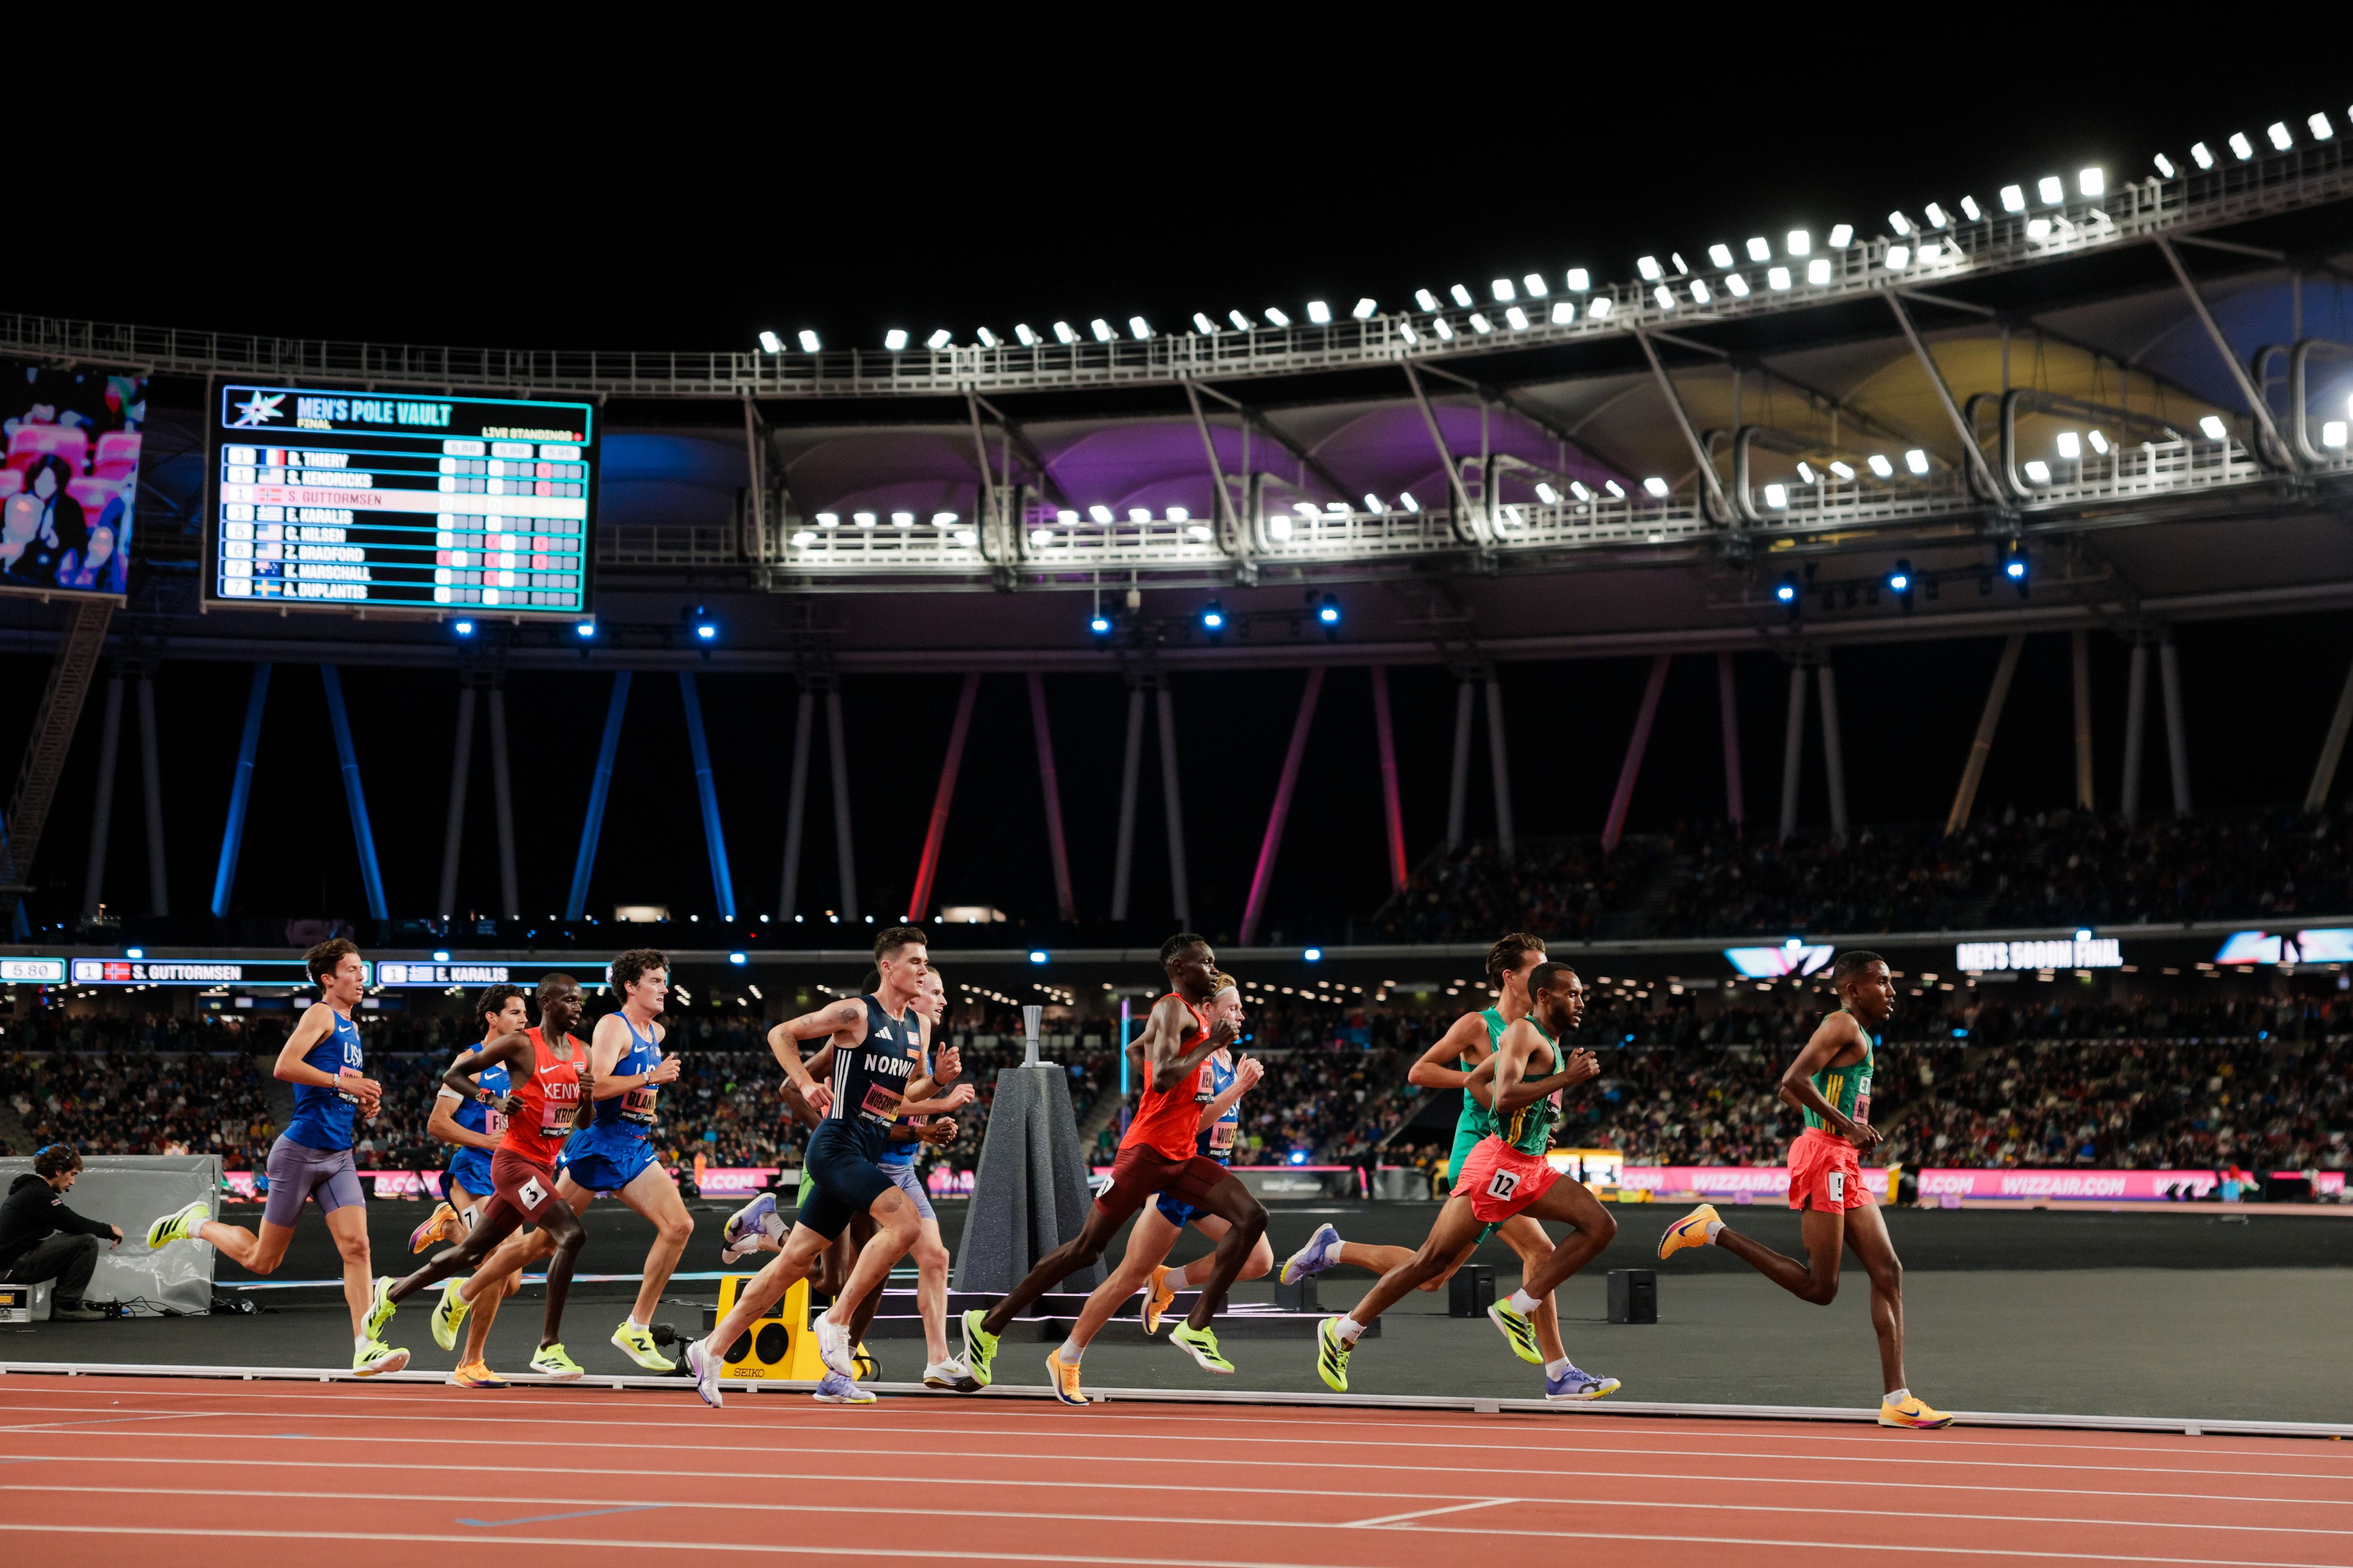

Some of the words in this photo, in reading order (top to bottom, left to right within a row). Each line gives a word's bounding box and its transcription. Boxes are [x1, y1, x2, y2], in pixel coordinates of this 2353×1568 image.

[297, 397, 349, 421] MEN'S
[351, 399, 394, 424] POLE
[396, 402, 452, 427] VAULT
[297, 418, 332, 429] FINAL
[482, 427, 509, 438] LIVE
[509, 428, 574, 441] STANDINGS
[240, 451, 245, 463] 1
[288, 451, 302, 466] B.
[302, 452, 349, 468] THIERY
[239, 469, 244, 482] 1
[287, 469, 301, 485] S.
[301, 470, 373, 488] KENDRICKS
[238, 488, 244, 500] 1
[288, 491, 299, 503] S.
[302, 491, 382, 506] GUTTORMSEN
[238, 507, 244, 519] 1
[286, 506, 300, 522] E.
[300, 508, 354, 525] KARALIS
[235, 526, 244, 538] 5
[285, 526, 300, 541] C.
[300, 526, 346, 543] NILSEN
[491, 538, 497, 547] X
[538, 540, 544, 548] X
[234, 544, 244, 556] 6
[284, 544, 298, 560] Z.
[298, 545, 365, 562] BRADFORD
[442, 554, 448, 562] X
[489, 556, 496, 565] X
[537, 557, 544, 566] X
[235, 563, 242, 575] 7
[283, 563, 298, 578] K.
[298, 563, 372, 581] MARSCHALL
[488, 575, 495, 583] X
[234, 582, 242, 593] 7
[283, 581, 297, 597] A.
[298, 582, 368, 599] DUPLANTIS
[1957, 943, 2009, 970] MEN'S
[2009, 940, 2073, 969] 5000M
[2073, 939, 2123, 967] FINAL
[13, 965, 48, 976] 5.80
[85, 966, 94, 978] 1
[132, 965, 147, 980] S.
[148, 965, 241, 981] GUTTORMSEN
[390, 969, 398, 980] 1
[436, 967, 450, 981] E.
[451, 967, 508, 982] KARALIS
[344, 1042, 363, 1068] USA
[1494, 1174, 1514, 1196] 12
[2001, 1176, 2127, 1196] WIZZAIR.COM
[526, 1186, 539, 1202] 3
[465, 1211, 472, 1229] 7
[734, 1368, 765, 1378] SEIKO
